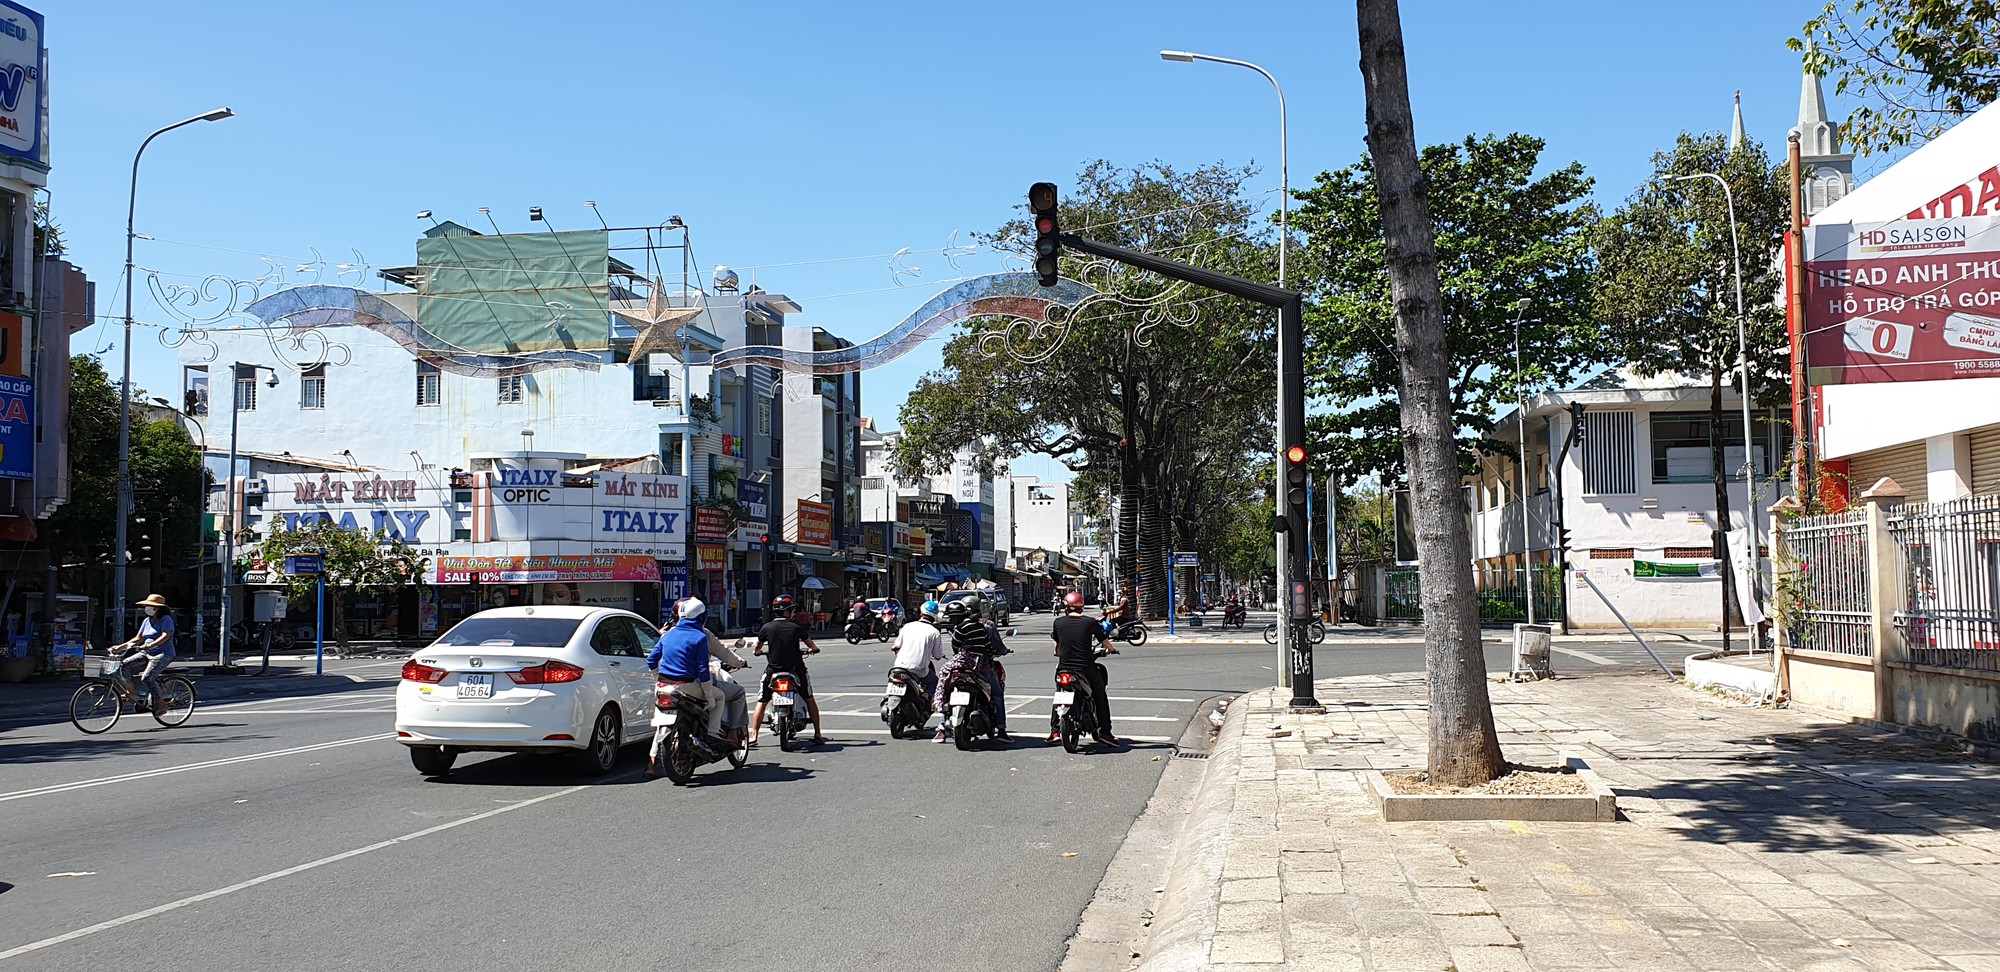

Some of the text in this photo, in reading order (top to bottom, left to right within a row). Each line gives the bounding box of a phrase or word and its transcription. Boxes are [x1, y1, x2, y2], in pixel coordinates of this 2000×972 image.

[1859, 225, 1965, 246] HD SAISON
[1819, 267, 1887, 288] HEAD
[1895, 263, 1948, 284] ANH
[1829, 292, 1858, 314] HỖ
[1863, 294, 1905, 314] TRỢ
[1914, 289, 1953, 310] TRẢ
[1872, 322, 1898, 354] 0
[1969, 326, 1995, 337] CMND
[1953, 361, 1976, 370] 1900
[13, 381, 32, 394] CẤP
[500, 469, 558, 486] ITALY
[962, 479, 975, 488] ANH
[294, 473, 416, 501] MẮT KÍNH
[605, 474, 679, 498] MẮT KÍNH
[503, 488, 551, 503] OPTIC
[602, 510, 679, 534] ITALY
[421, 548, 432, 556] Bà
[444, 558, 465, 570] Vui
[468, 558, 491, 570] Đón
[494, 557, 512, 569] Tết
[522, 557, 546, 570] Siêu
[444, 572, 471, 582] SALE
[478, 572, 500, 581] 0%
[662, 566, 687, 575] TRANG
[466, 675, 484, 686] 60A
[458, 686, 490, 697] 405.64
